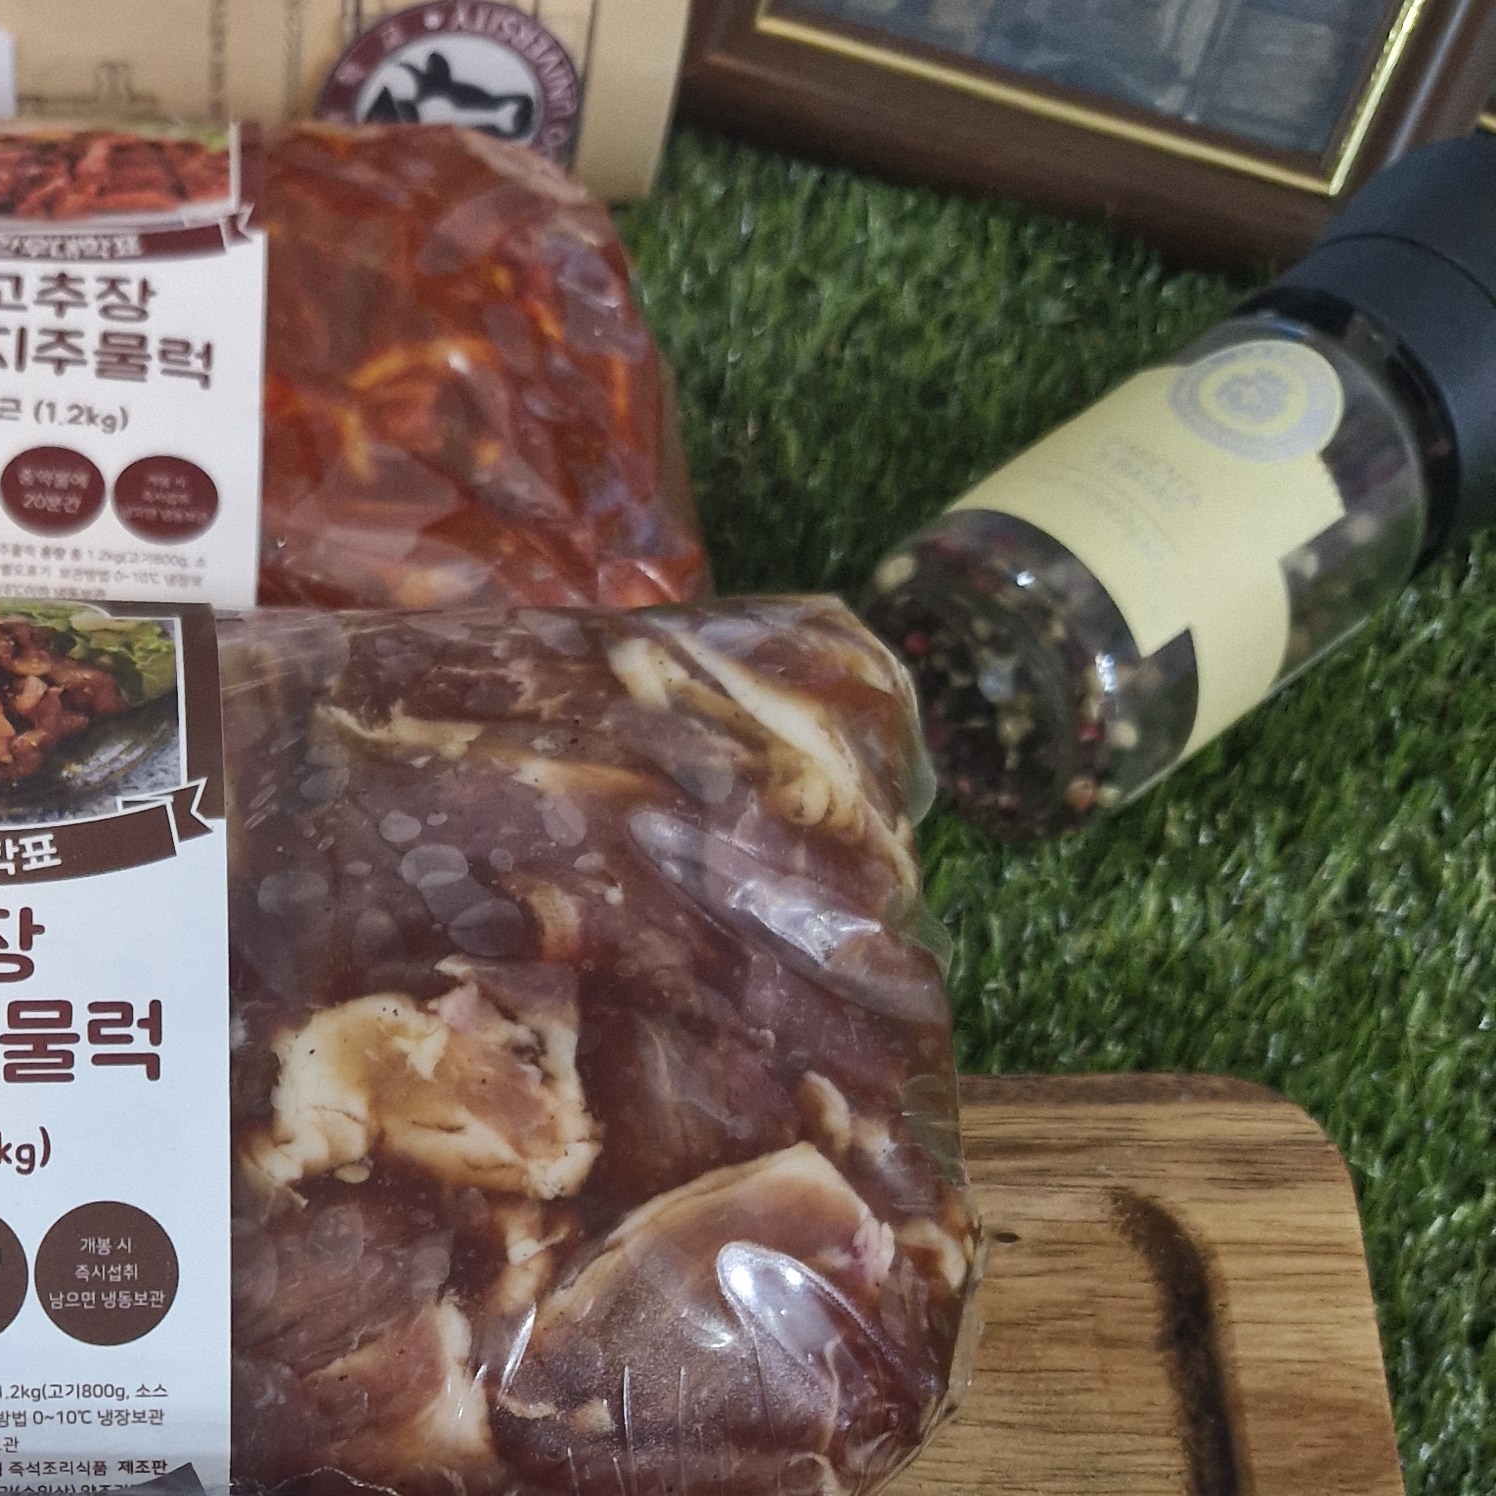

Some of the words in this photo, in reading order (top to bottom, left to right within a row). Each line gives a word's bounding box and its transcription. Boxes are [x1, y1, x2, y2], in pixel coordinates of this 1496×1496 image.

[34, 399, 130, 434] (1.2kg)
[79, 1236, 111, 1256] 개봉
[116, 1237, 132, 1255] 시
[74, 1263, 139, 1283] 즉시섭취
[48, 1290, 96, 1310] 남으면
[101, 1290, 166, 1309] 냉동보관
[135, 1383, 168, 1398] 소스
[97, 1409, 165, 1426] 냉장보관
[8, 1460, 108, 1477] 즉석조리식품
[117, 1459, 168, 1476] 제조판
